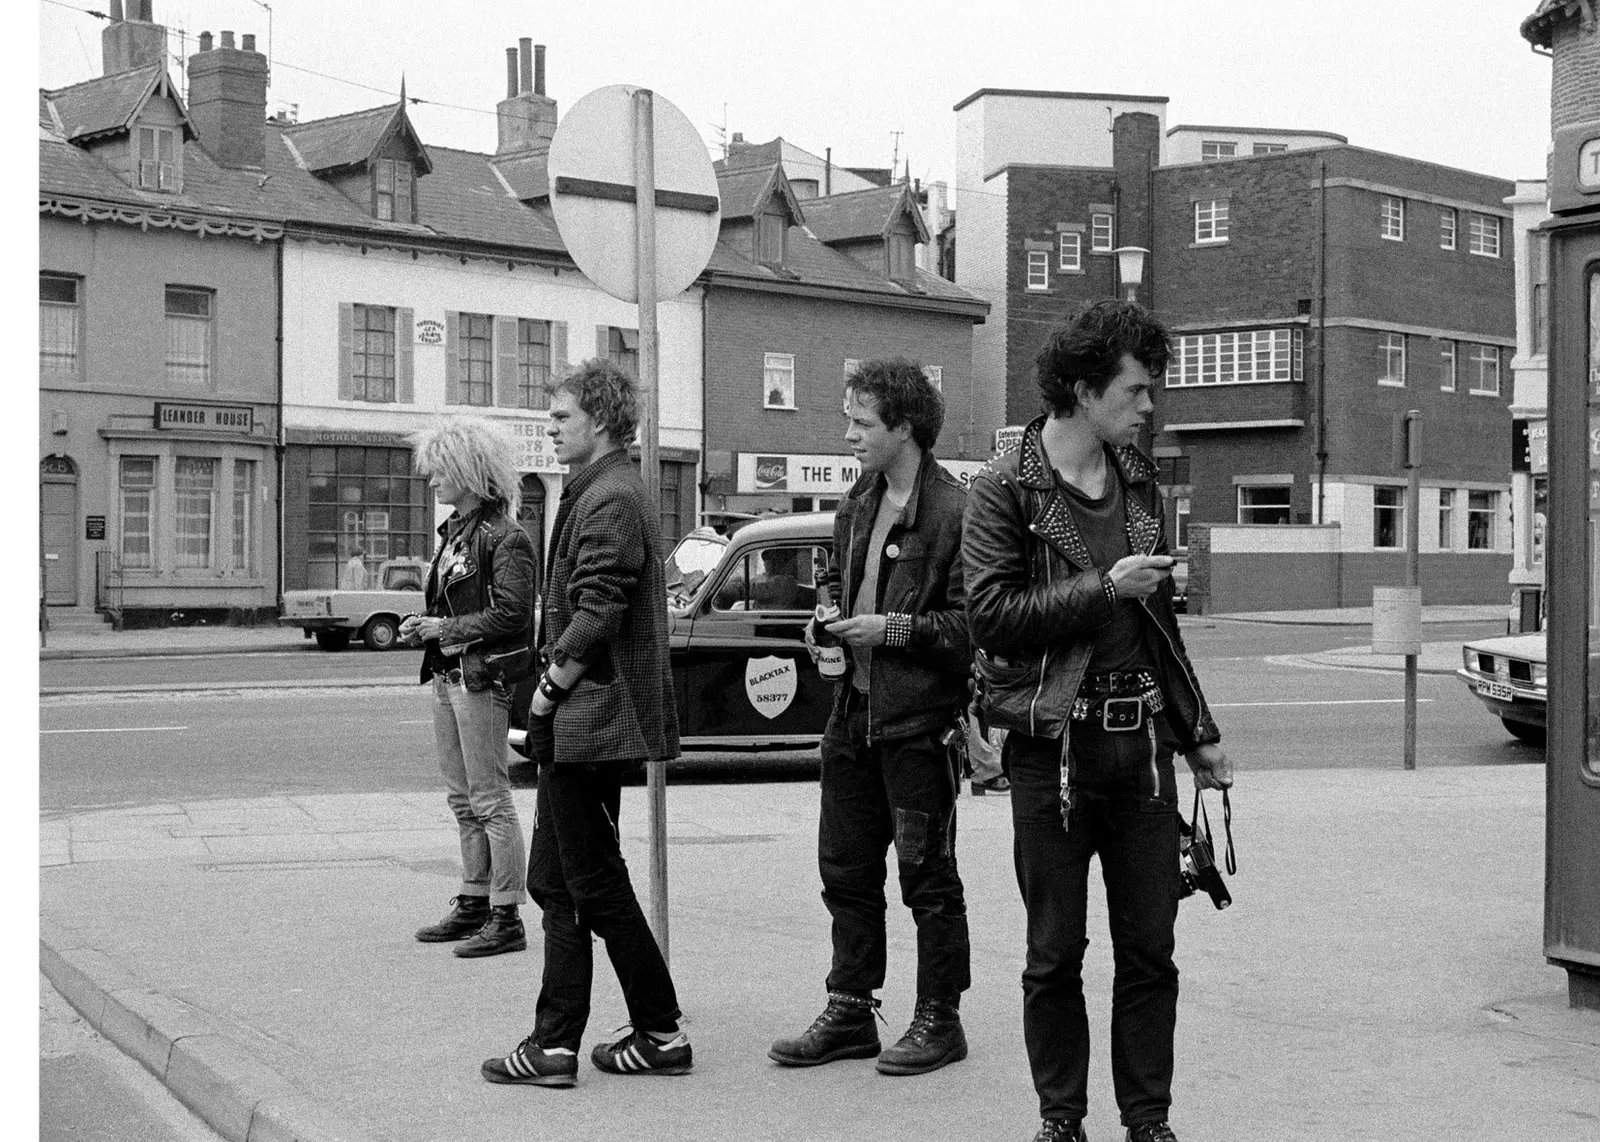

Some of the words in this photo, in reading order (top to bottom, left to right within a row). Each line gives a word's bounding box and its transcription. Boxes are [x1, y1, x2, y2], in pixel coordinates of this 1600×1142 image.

[1590, 151, 1600, 174] T
[163, 409, 205, 424] LEANDER
[216, 412, 248, 426] HOUSE
[513, 424, 545, 437] HER
[801, 466, 832, 482] THE
[818, 656, 842, 664] AGNE
[749, 665, 791, 686] BLACKTAX
[756, 693, 789, 703] 58377
